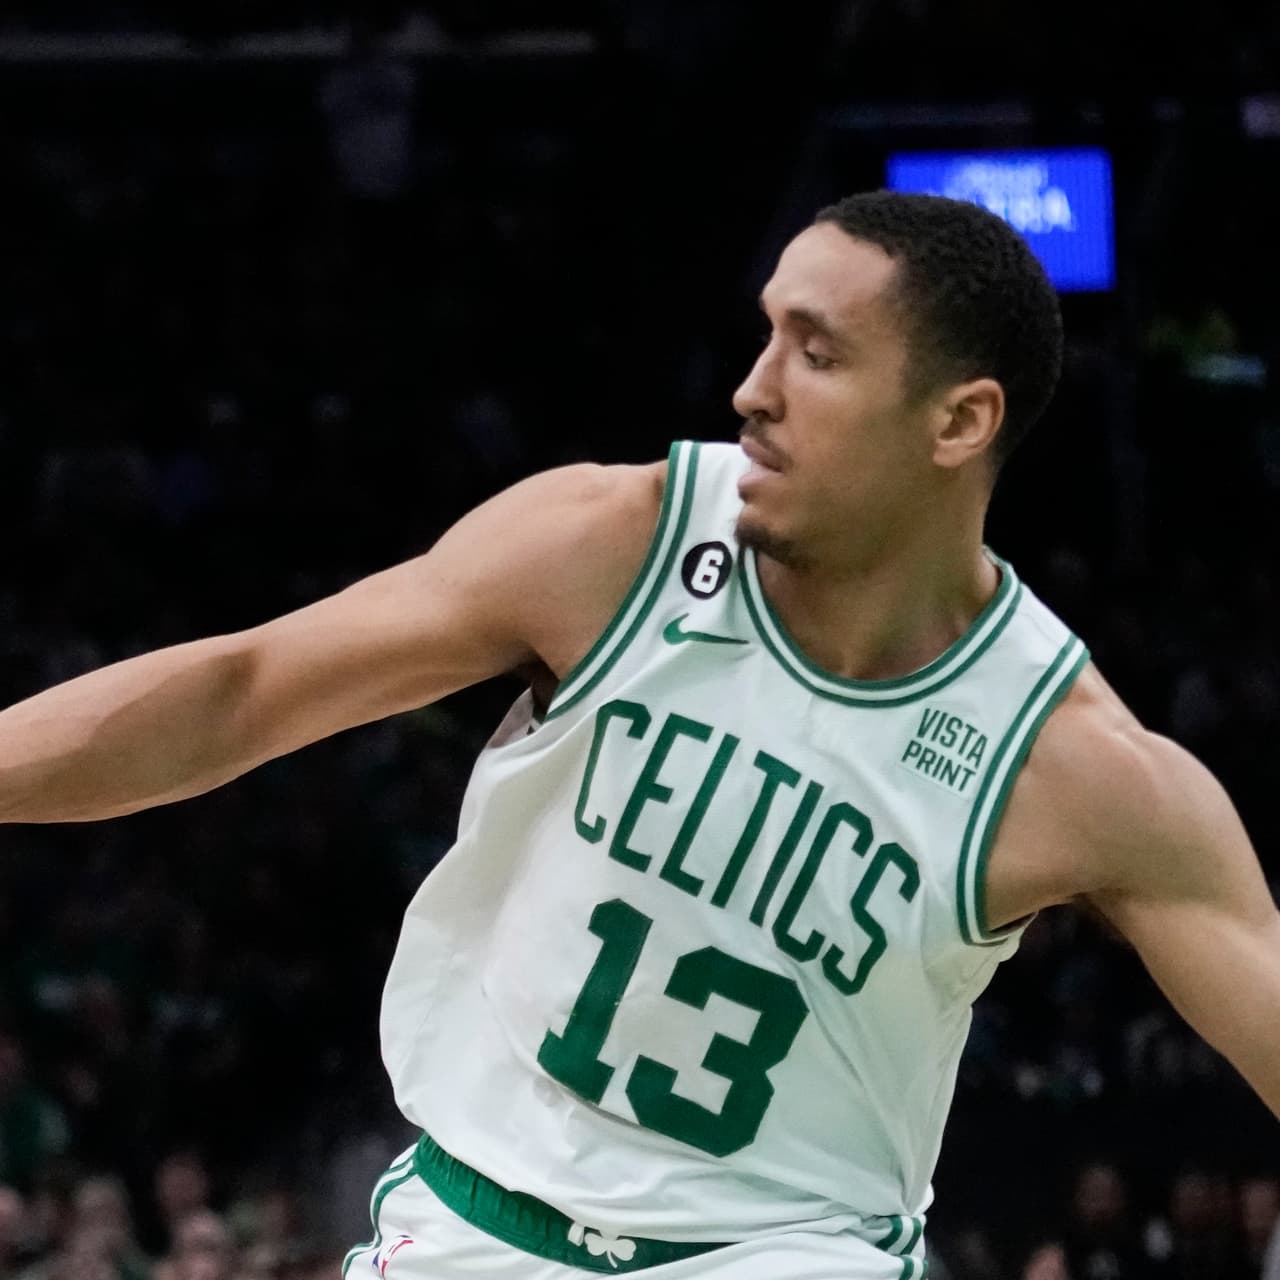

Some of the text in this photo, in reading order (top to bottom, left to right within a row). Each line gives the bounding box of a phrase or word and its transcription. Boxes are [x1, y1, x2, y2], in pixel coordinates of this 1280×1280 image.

[690, 549, 725, 594] 6
[901, 739, 977, 792] PRINT
[916, 707, 989, 769] VISTA
[573, 698, 920, 996] CELTICS
[536, 897, 810, 1158] 13
